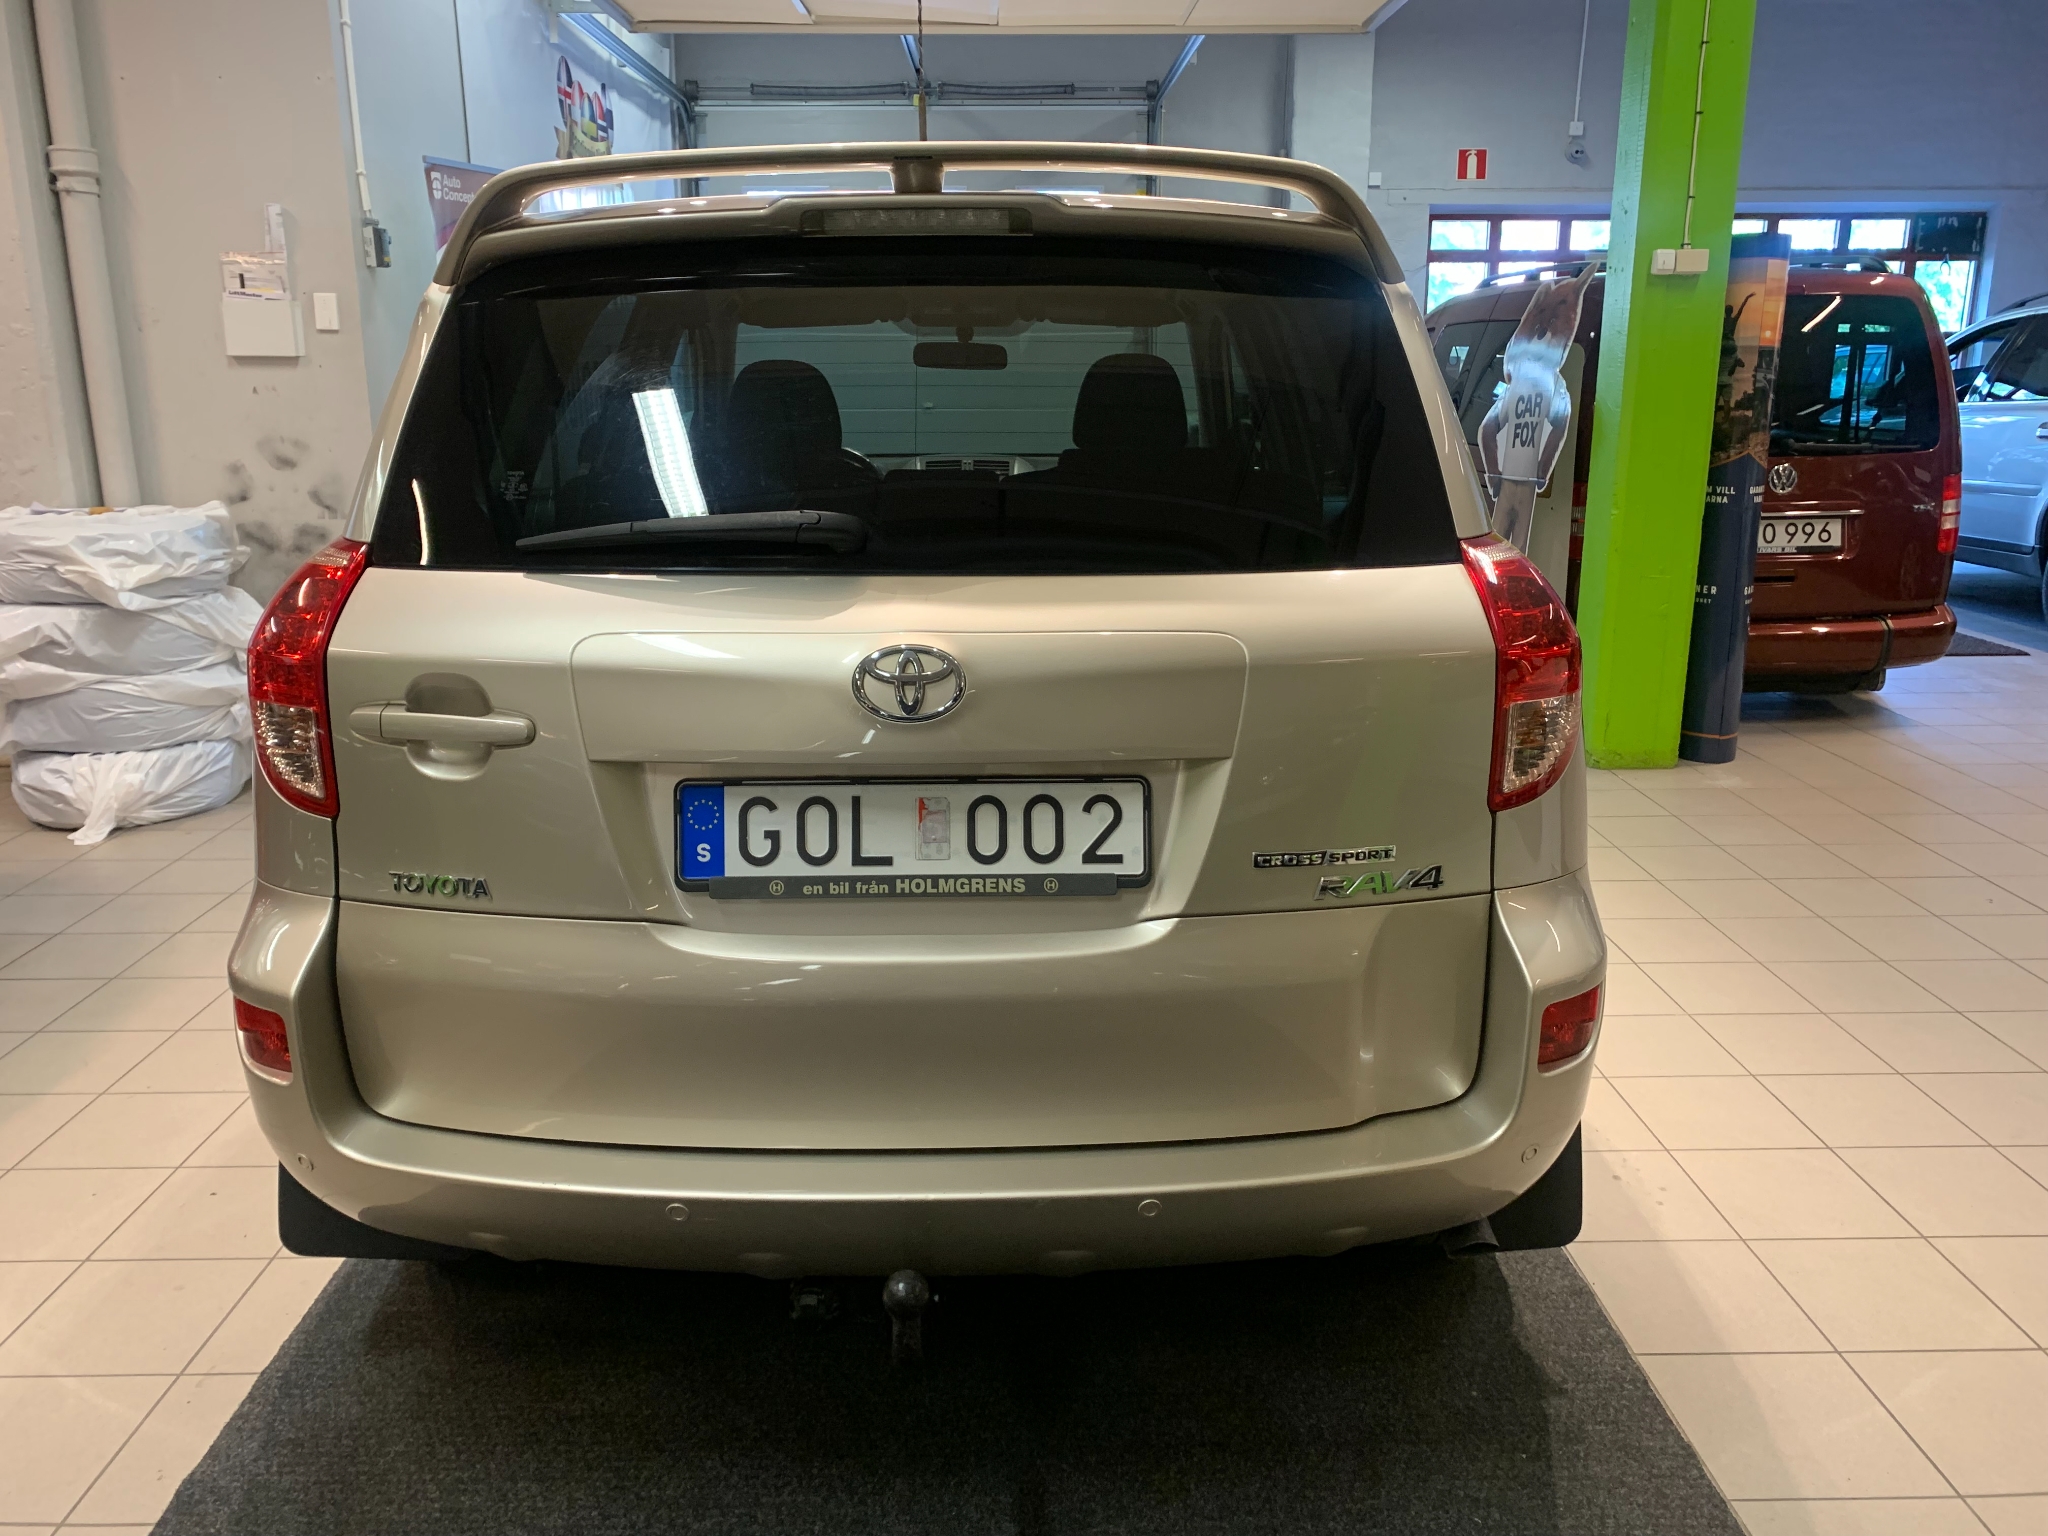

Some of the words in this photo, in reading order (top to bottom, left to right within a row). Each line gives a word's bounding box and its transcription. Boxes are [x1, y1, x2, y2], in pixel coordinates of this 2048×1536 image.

[443, 174, 461, 189] Auto
[1515, 392, 1543, 420] CAR
[1512, 420, 1539, 449] FOX
[1716, 486, 1736, 494] VILL
[1784, 521, 1832, 544] 996
[738, 795, 894, 867] GOL
[966, 793, 1125, 865] 002
[696, 843, 712, 863] S
[1257, 853, 1323, 867] CROSS
[1327, 849, 1393, 864] SPORT
[389, 870, 493, 900] TOYOTA
[803, 884, 822, 895] en
[828, 882, 850, 895] bil
[855, 879, 889, 894] från
[896, 877, 1026, 895] HOLMGRENS
[1314, 864, 1445, 901] RAV4
